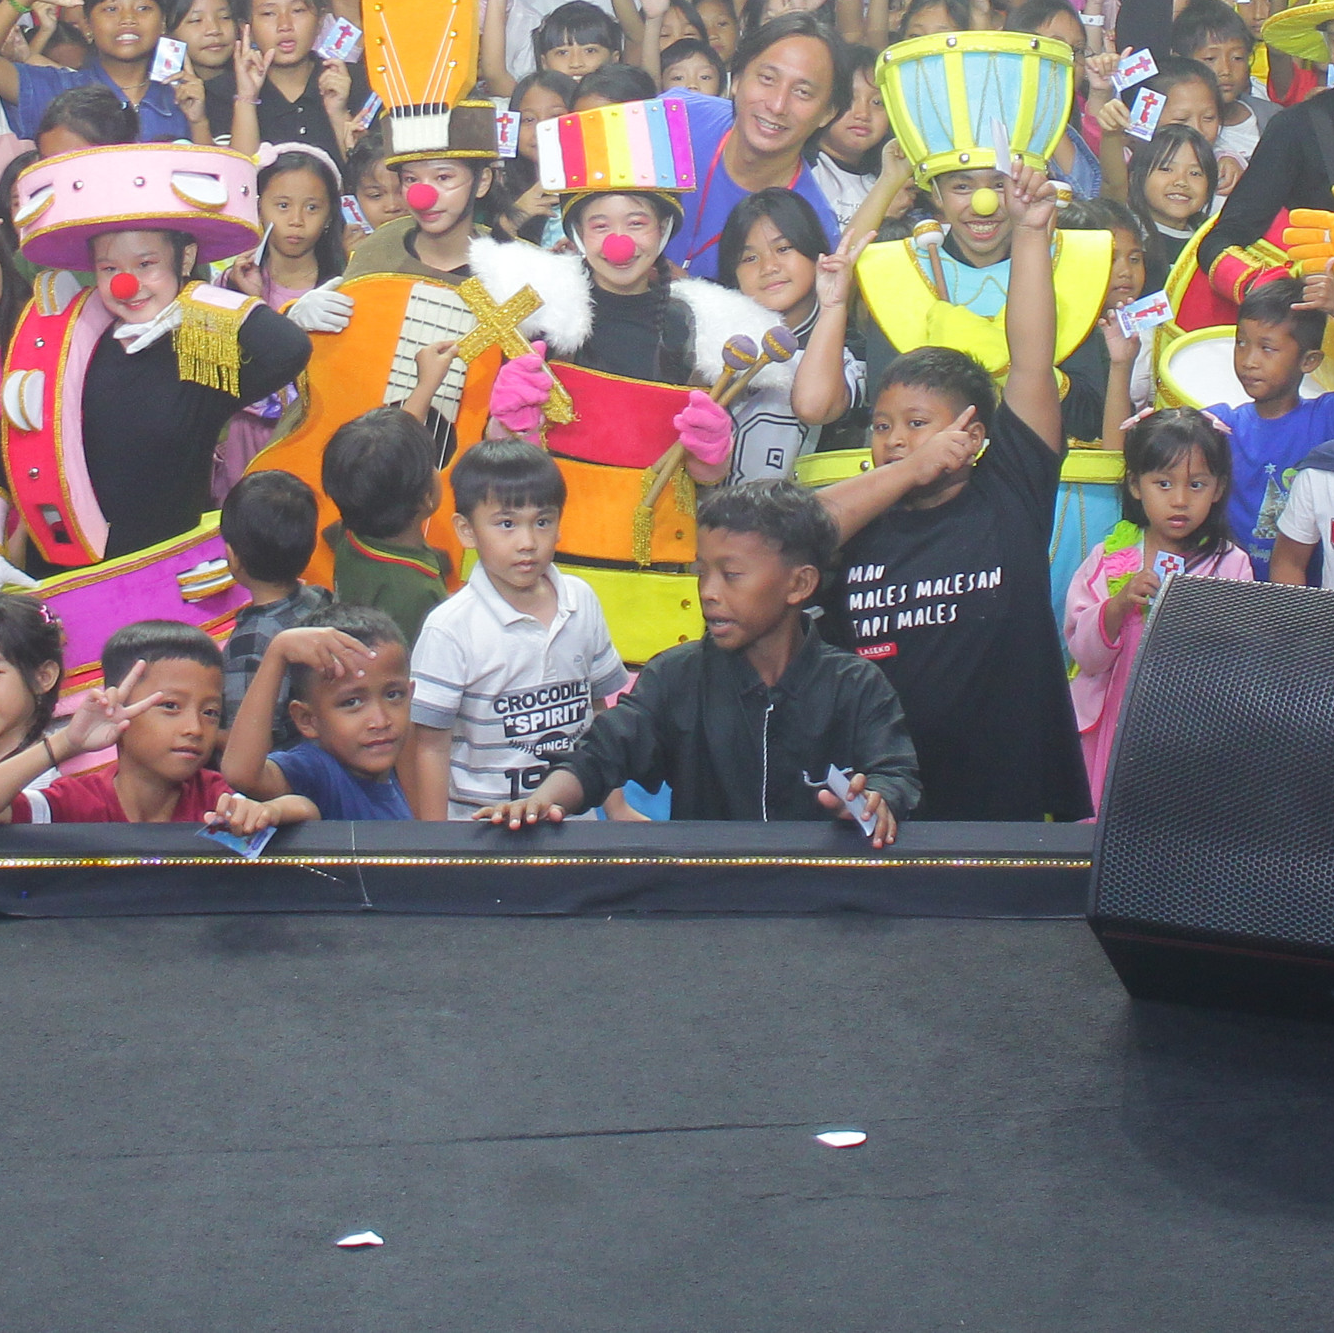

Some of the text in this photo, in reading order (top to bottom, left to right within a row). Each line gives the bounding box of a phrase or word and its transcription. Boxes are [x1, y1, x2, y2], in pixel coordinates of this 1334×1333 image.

[848, 564, 885, 585] MAU
[849, 567, 1002, 613] MALES MALESAN
[853, 604, 958, 638] TAPI MALES
[515, 698, 579, 733] SPIRIT
[535, 737, 569, 756] SINCE
